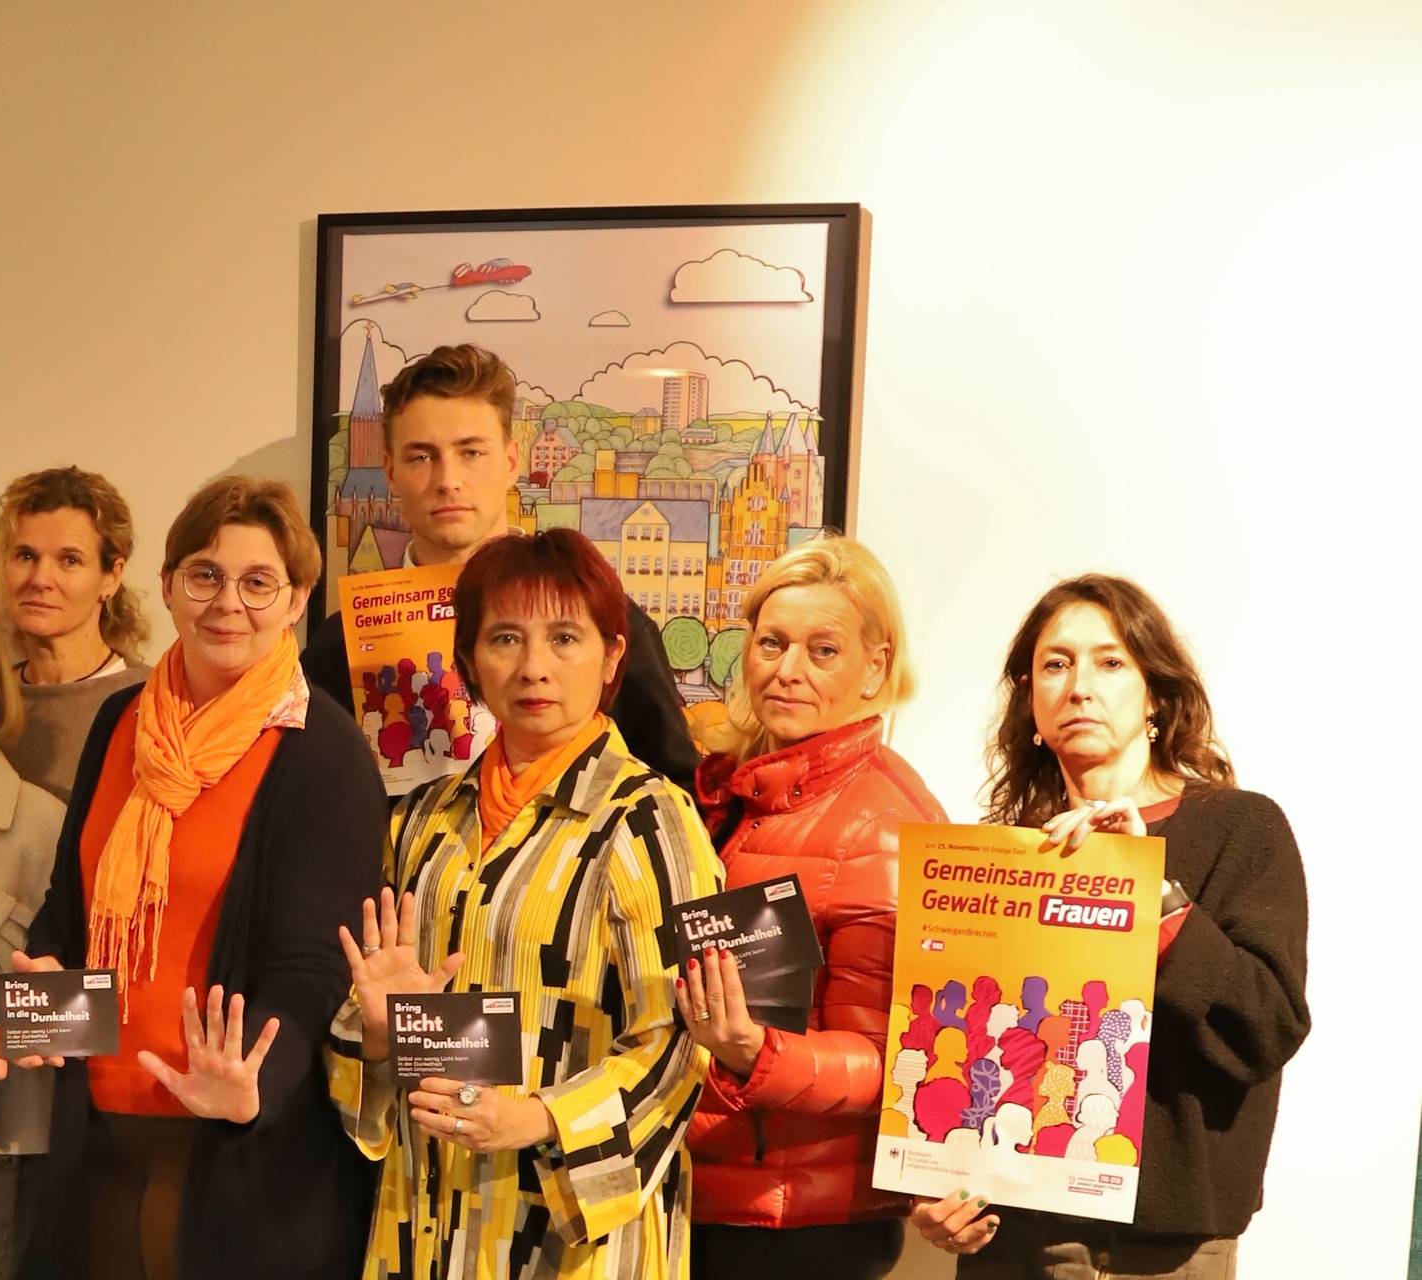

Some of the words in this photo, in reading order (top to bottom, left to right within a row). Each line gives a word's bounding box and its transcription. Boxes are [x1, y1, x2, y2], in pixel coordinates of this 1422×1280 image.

[353, 588, 434, 610] Gemeinsam
[355, 608, 402, 628] Gewalt
[406, 609, 424, 622] an
[431, 604, 455, 619] Fra
[923, 858, 1056, 889] Gemeinsam
[1059, 872, 1135, 897] gegen
[681, 909, 709, 922] Bring
[922, 889, 999, 916] Gewalt
[1003, 900, 1032, 918] an
[1043, 898, 1128, 928] Frauen
[684, 914, 735, 940] Licht
[691, 943, 701, 952] in
[702, 939, 717, 950] die
[718, 926, 782, 950] Dunkelheit
[4, 981, 29, 991] Bring
[6, 990, 49, 1008] Licht
[7, 1010, 15, 1018] in
[16, 1010, 30, 1018] die
[31, 1011, 90, 1022] Dunkelheit
[395, 1003, 422, 1014] Bring
[396, 1014, 444, 1032] Licht
[397, 1035, 406, 1044] in
[408, 1035, 422, 1044] die
[423, 1038, 490, 1049] Dunkelheit
